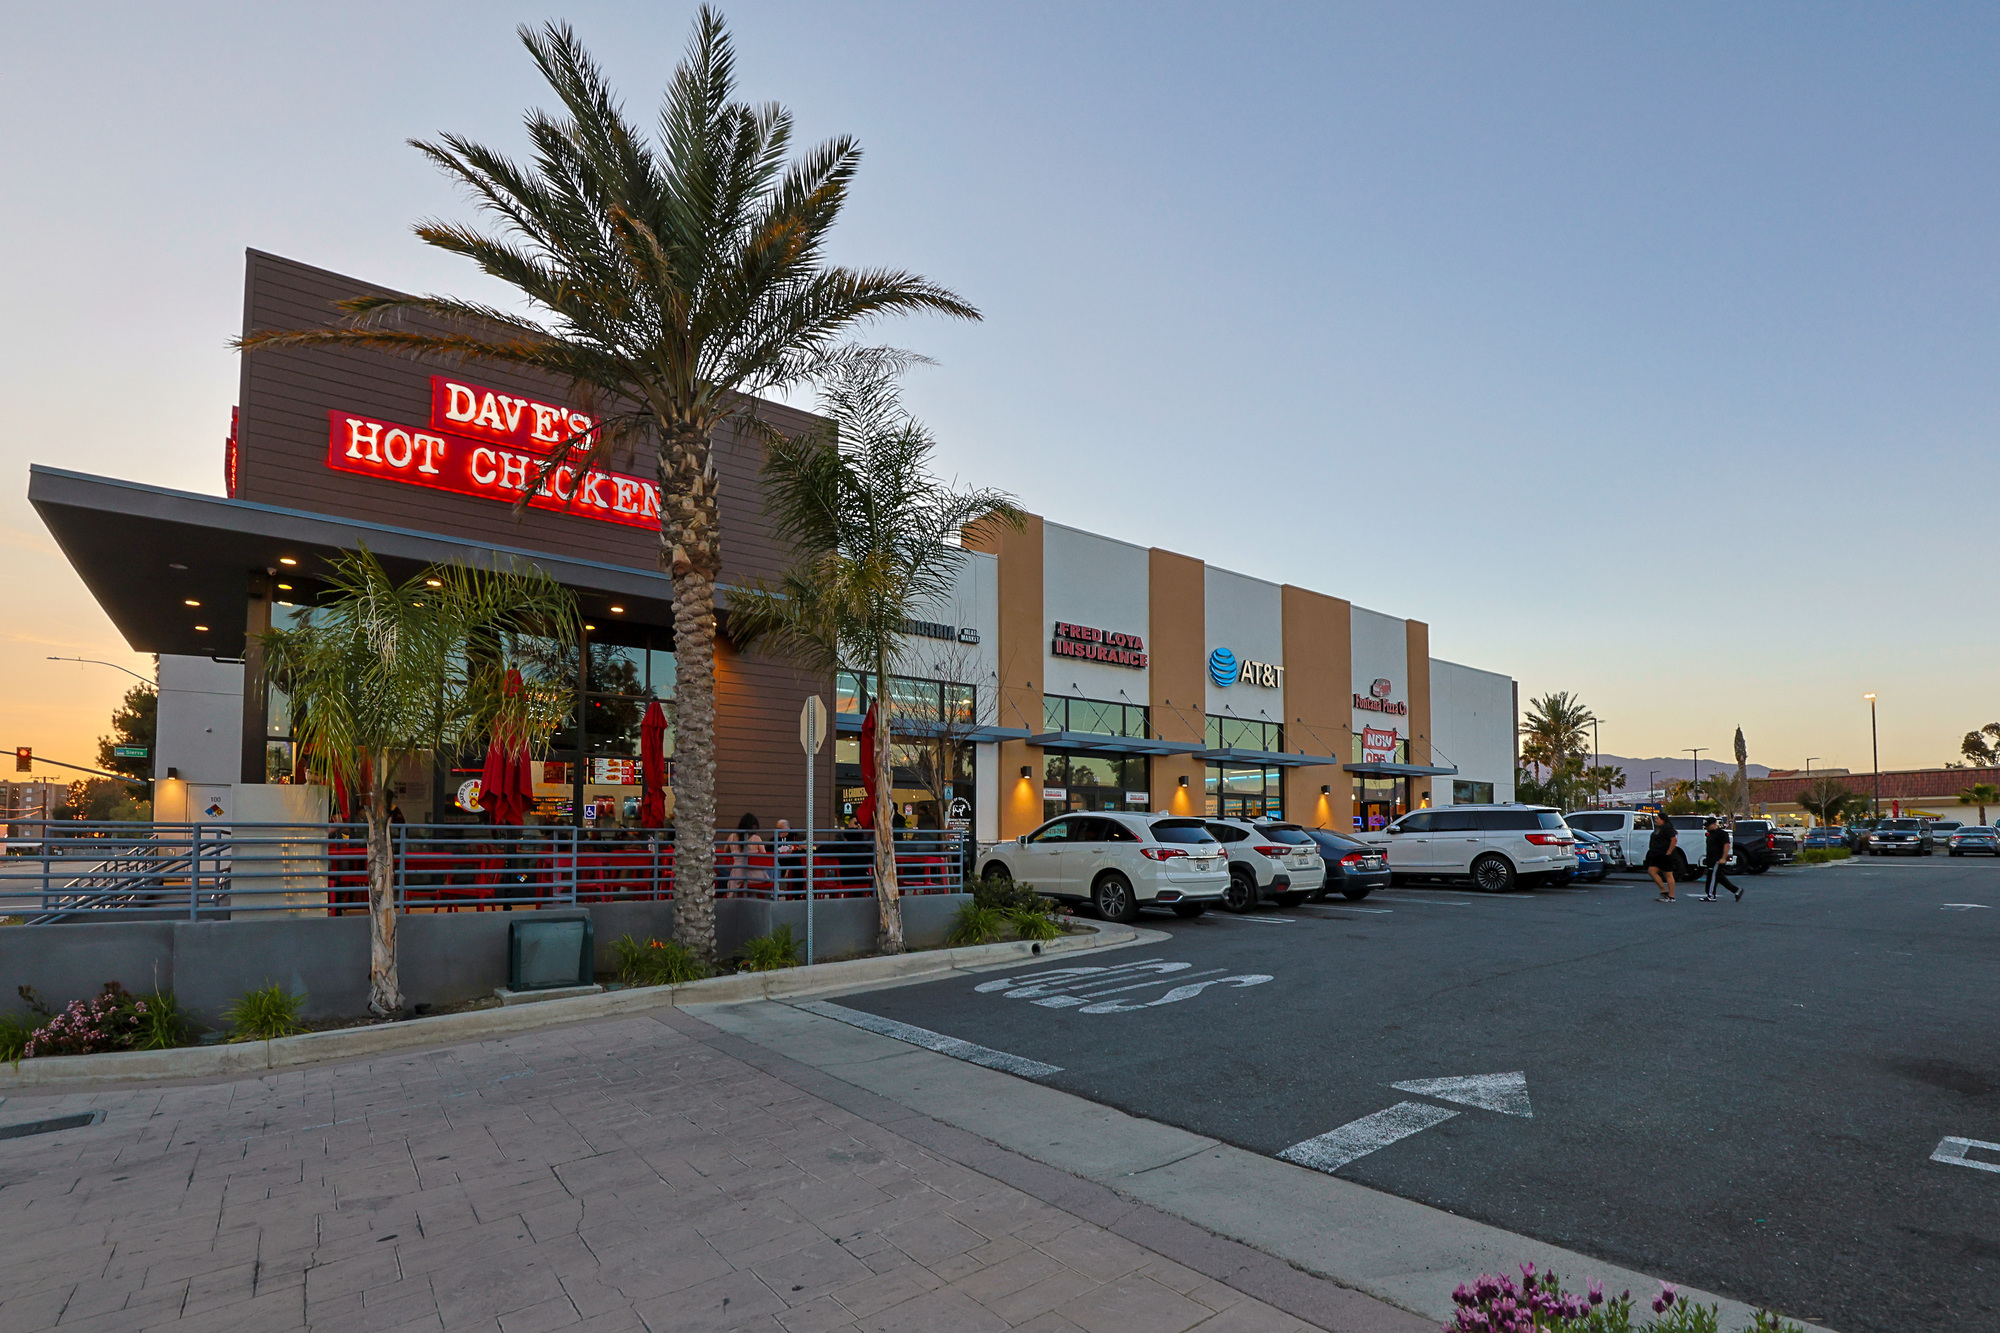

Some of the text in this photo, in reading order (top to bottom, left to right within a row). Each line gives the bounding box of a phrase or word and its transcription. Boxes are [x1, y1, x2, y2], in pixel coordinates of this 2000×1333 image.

[445, 383, 593, 451] DAVE'S
[345, 419, 662, 519] HOT CHICKEN
[961, 635, 980, 643] MARKET
[963, 628, 977, 636] MEAT
[1059, 622, 1145, 650] FRED LOYA
[1056, 639, 1149, 667] INSURANCE
[1240, 660, 1285, 688] AT&T
[1355, 693, 1408, 715] Fontana Pizza Co
[1367, 733, 1393, 747] NOW
